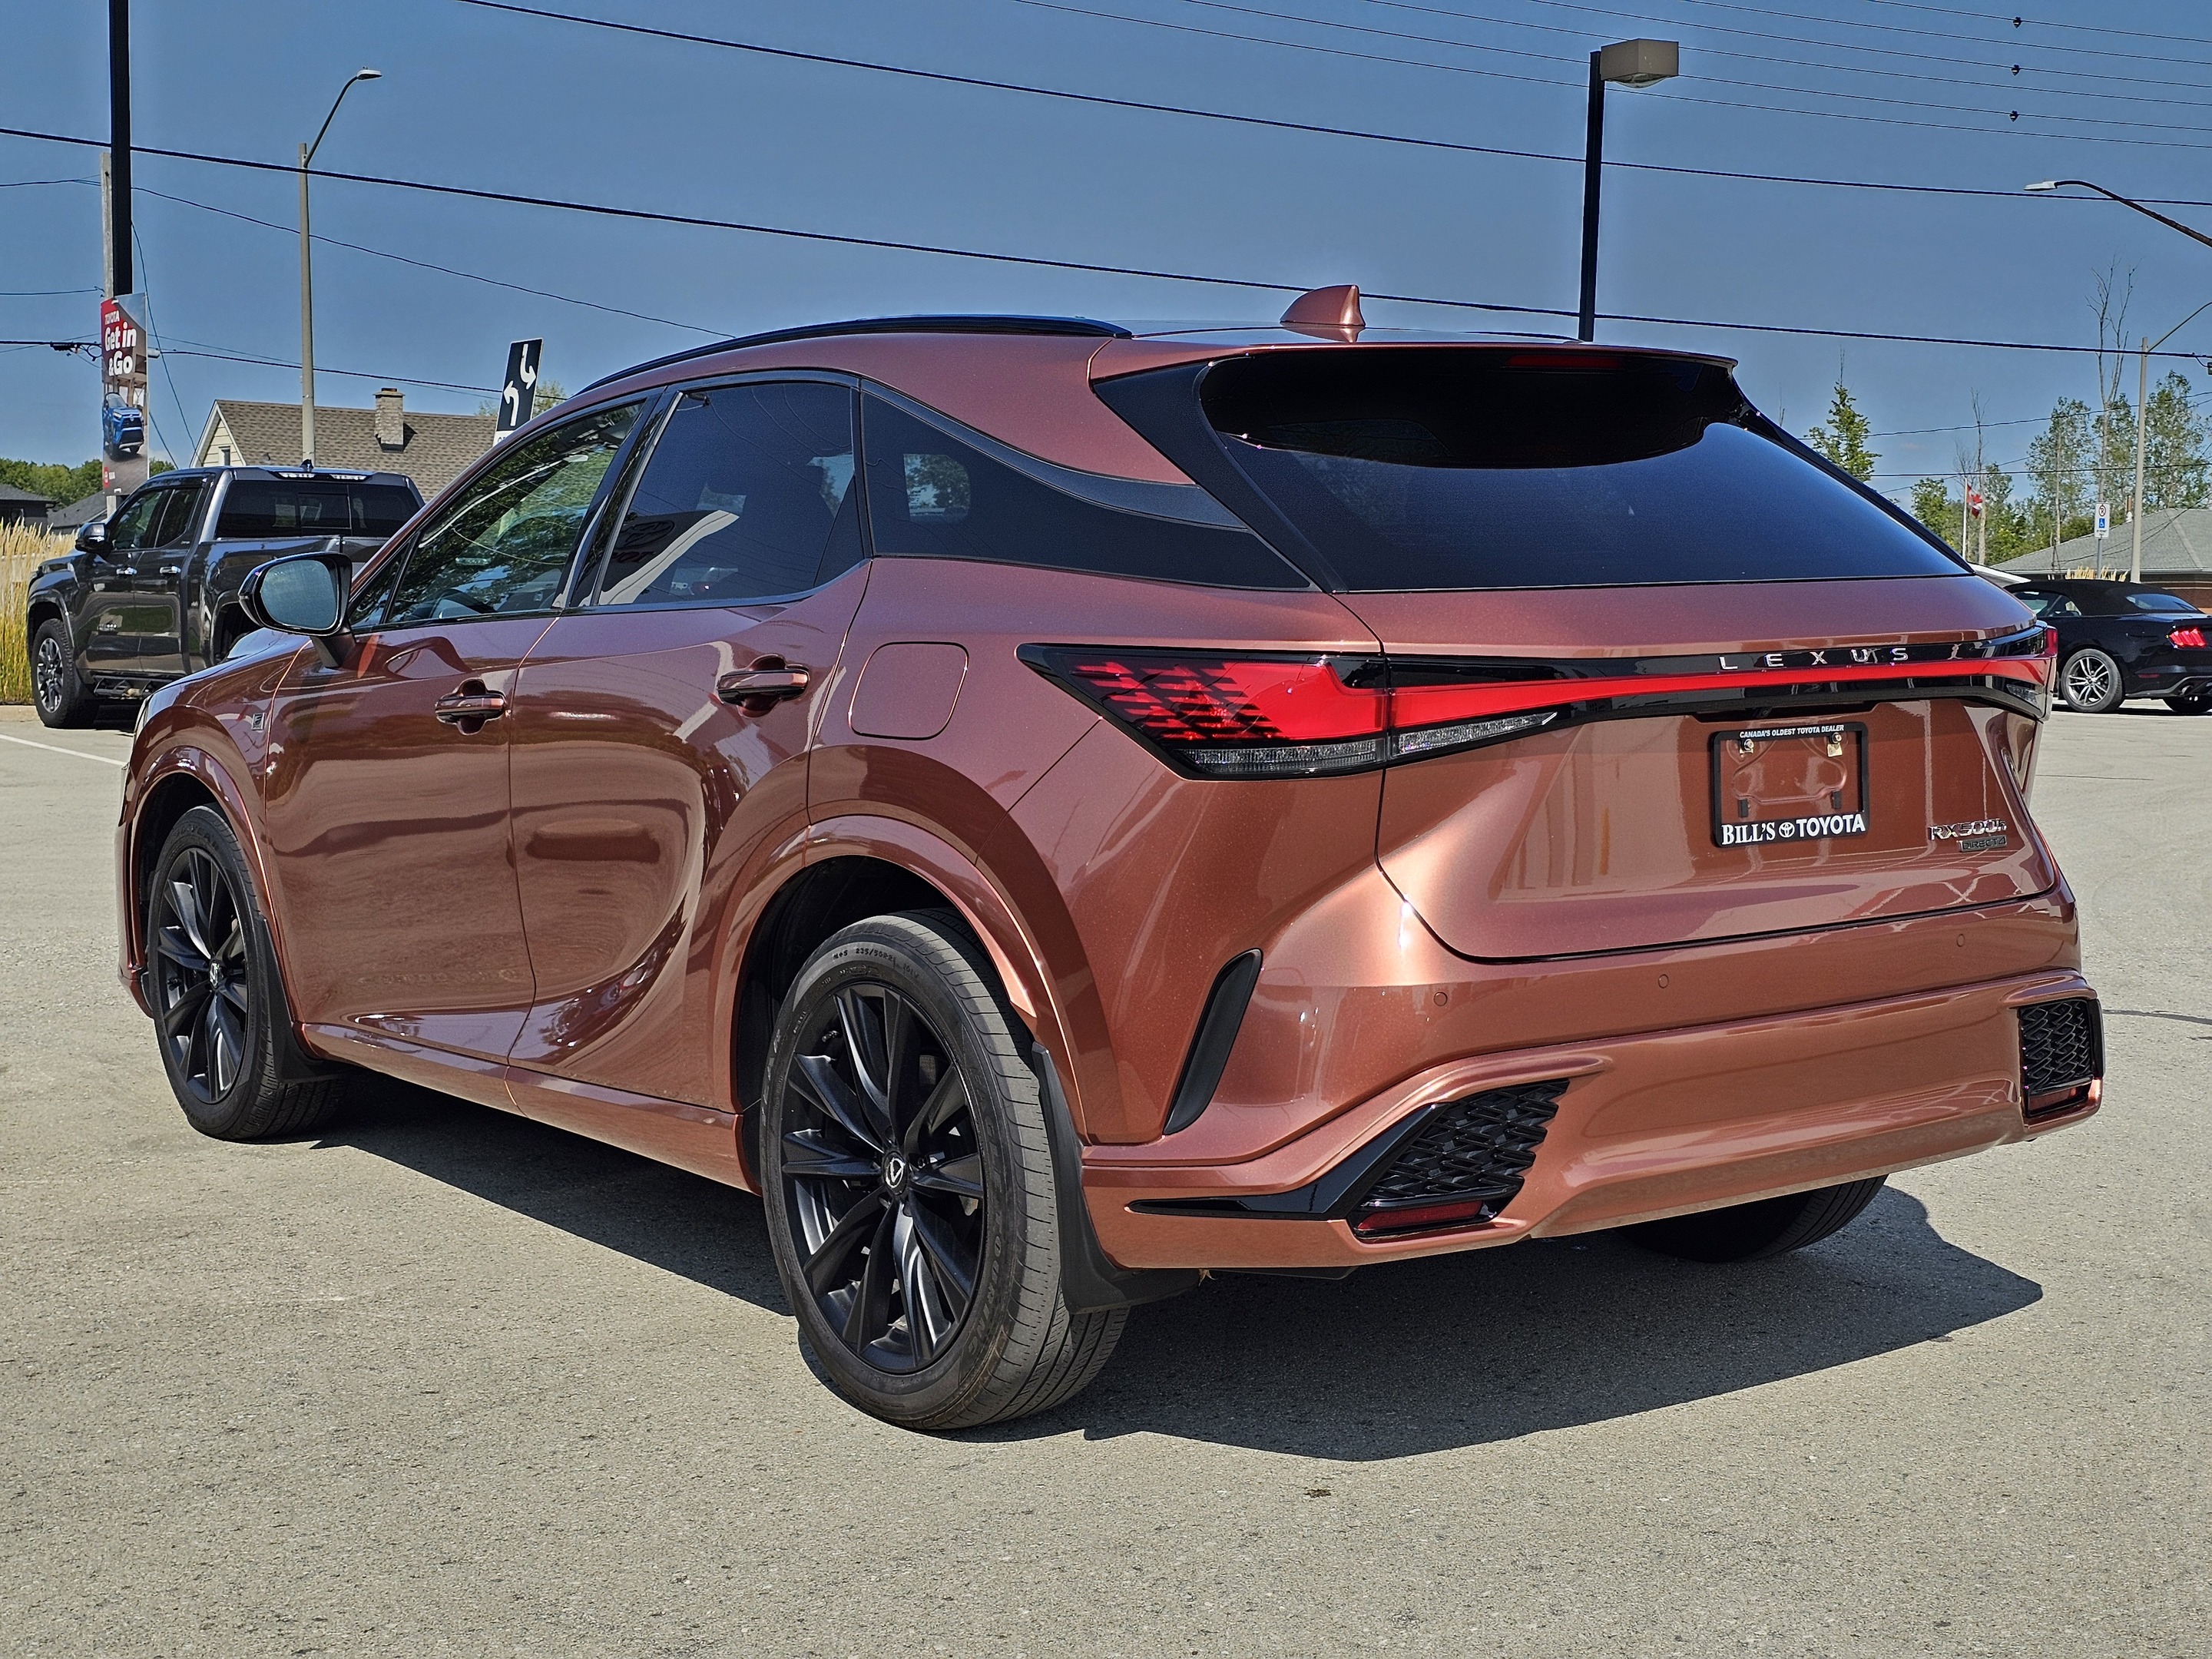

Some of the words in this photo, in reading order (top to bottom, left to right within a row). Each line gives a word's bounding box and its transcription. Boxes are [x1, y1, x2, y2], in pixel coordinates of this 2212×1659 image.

[105, 326, 121, 351] Get
[122, 322, 137, 348] in
[108, 350, 134, 376] &Go
[1719, 647, 1908, 671] LEXUS
[1739, 730, 1771, 738] CANADA'S
[1771, 728, 1796, 737] OLDEST
[1796, 726, 1820, 735] TOYOTA
[1821, 724, 1845, 733] DEALER
[1721, 822, 1776, 845] BILL'S
[1796, 813, 1866, 838] TOYOTA
